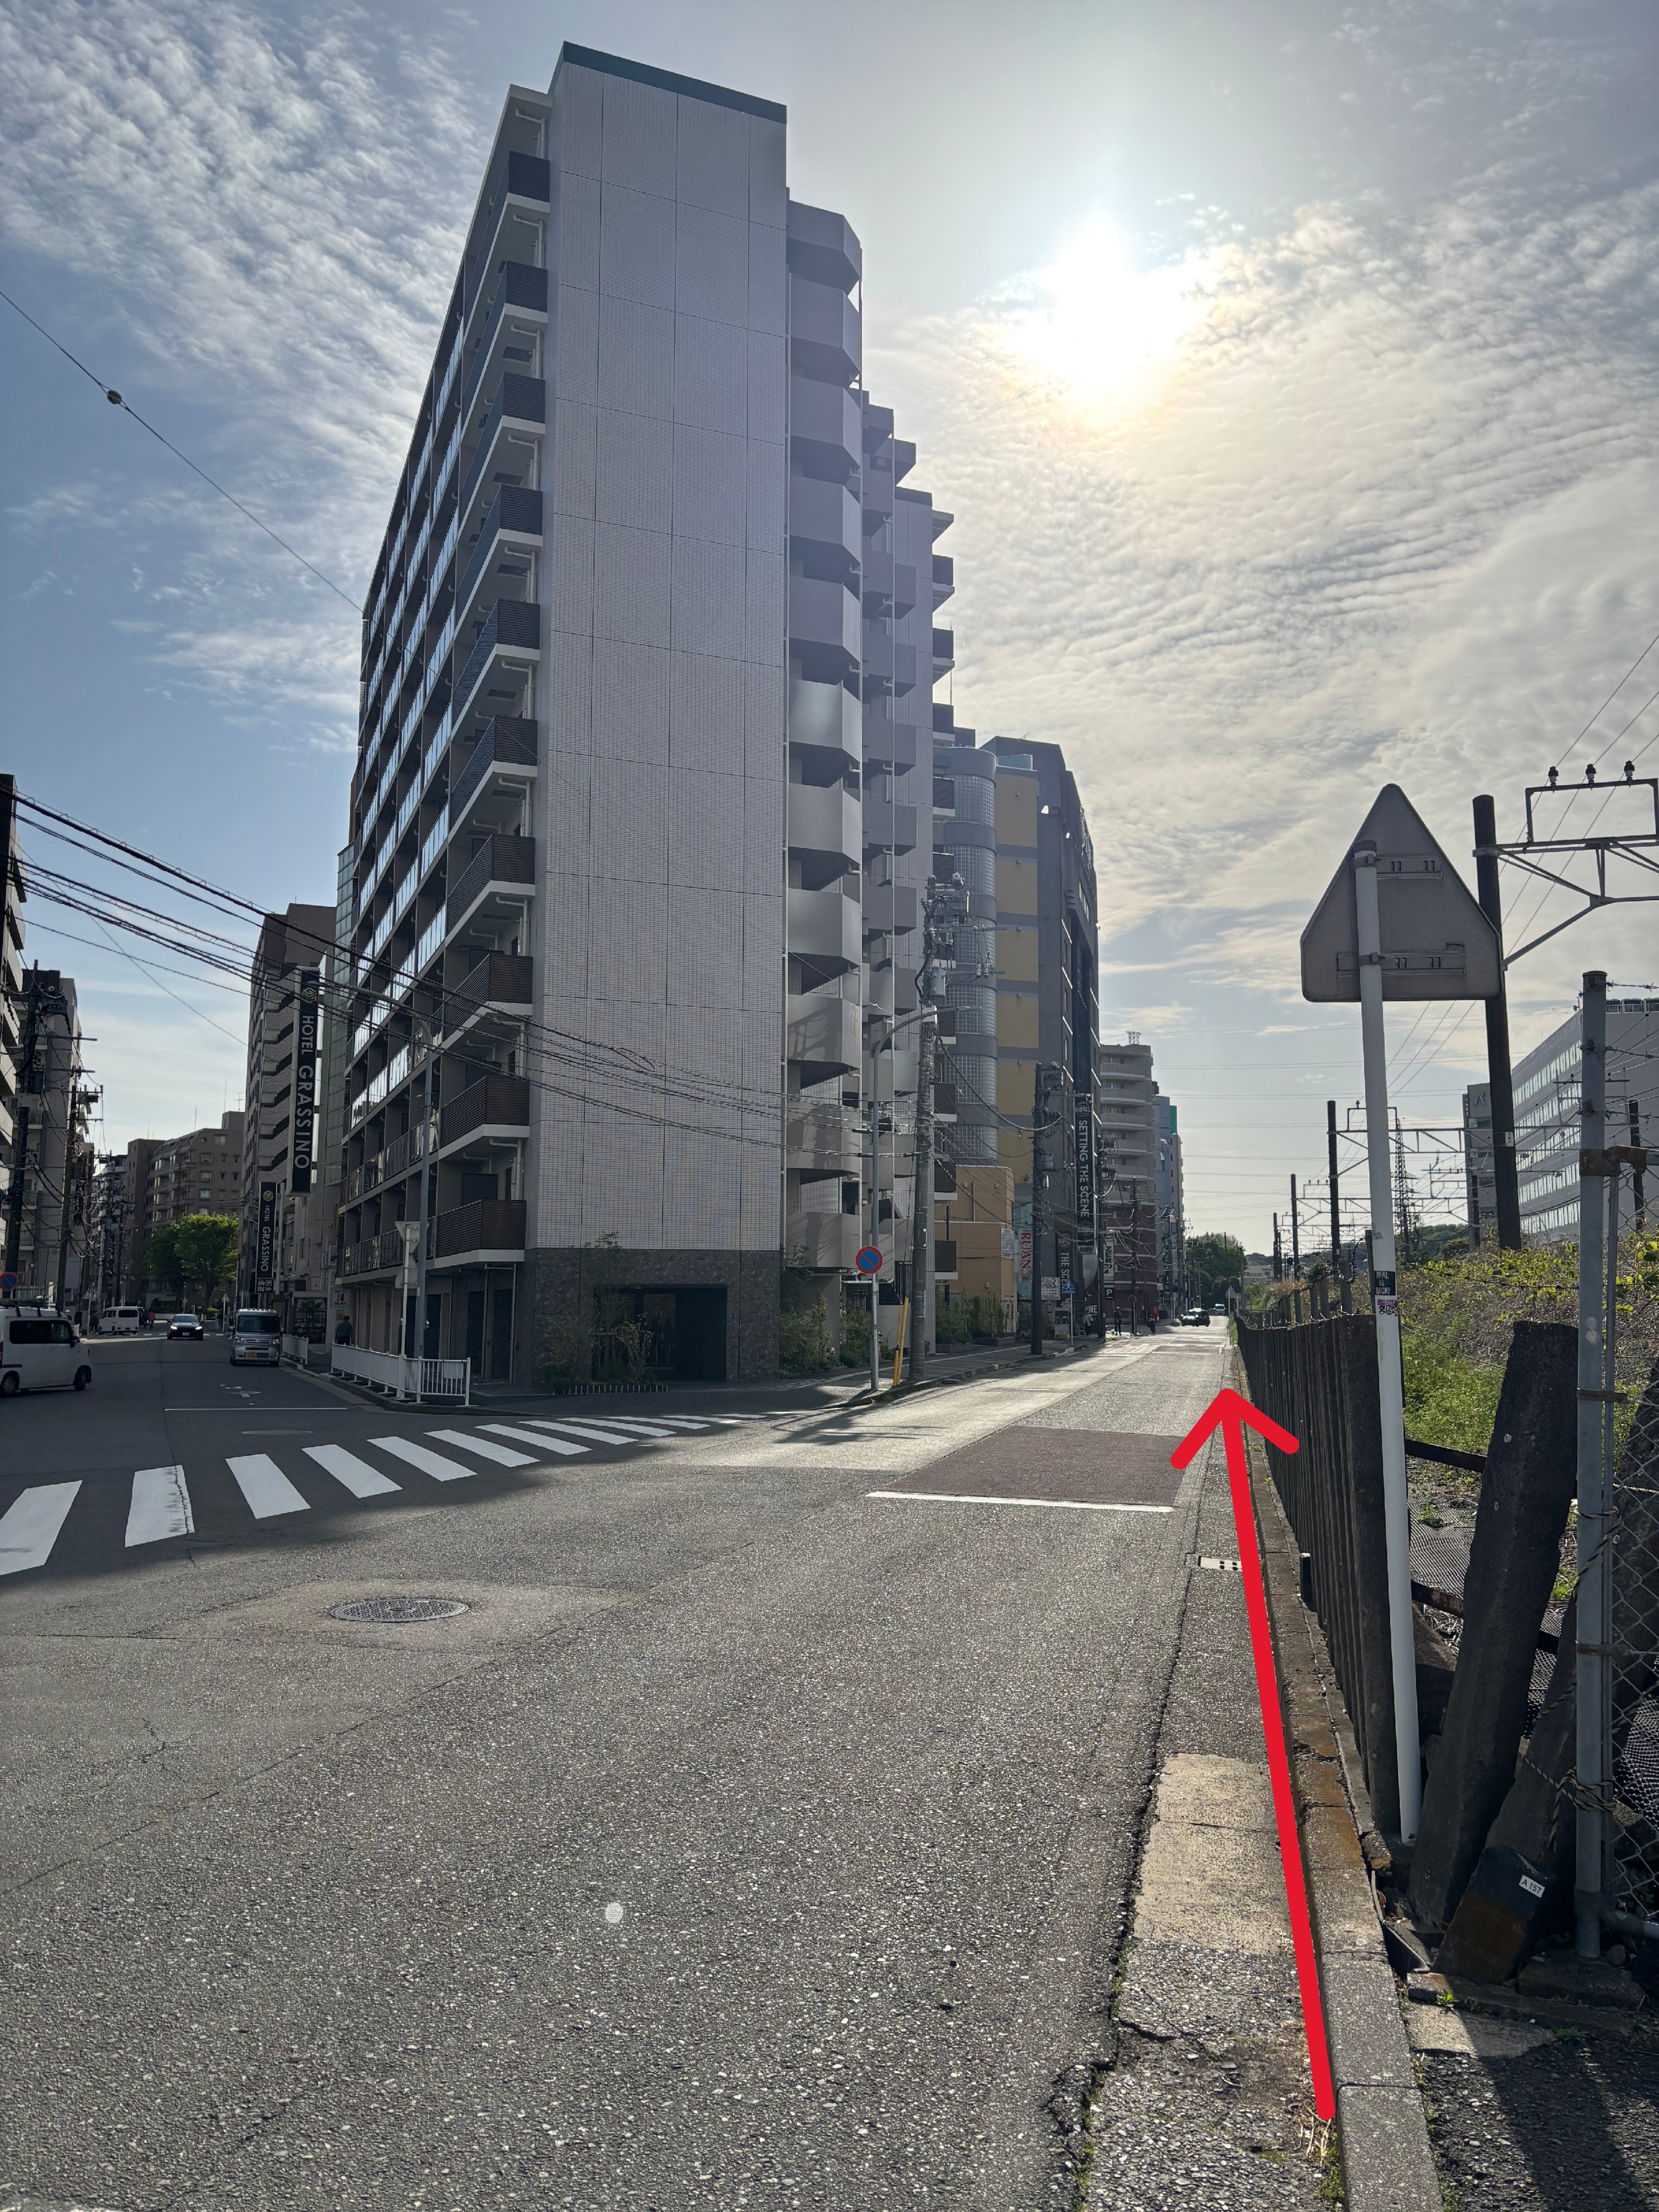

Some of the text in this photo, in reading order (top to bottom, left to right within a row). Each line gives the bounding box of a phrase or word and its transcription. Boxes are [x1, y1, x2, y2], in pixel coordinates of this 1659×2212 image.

[294, 1015, 314, 1169] HOTEL GRASSINO
[1079, 1120, 1088, 1162] SETTING
[1080, 1164, 1089, 1183] THE
[1080, 1185, 1089, 1218] SCENE
[261, 1226, 271, 1271] GRASSINO
[1021, 1233, 1032, 1268] RUAN
[1061, 1252, 1069, 1267] THE
[1061, 1269, 1070, 1291] SCE
